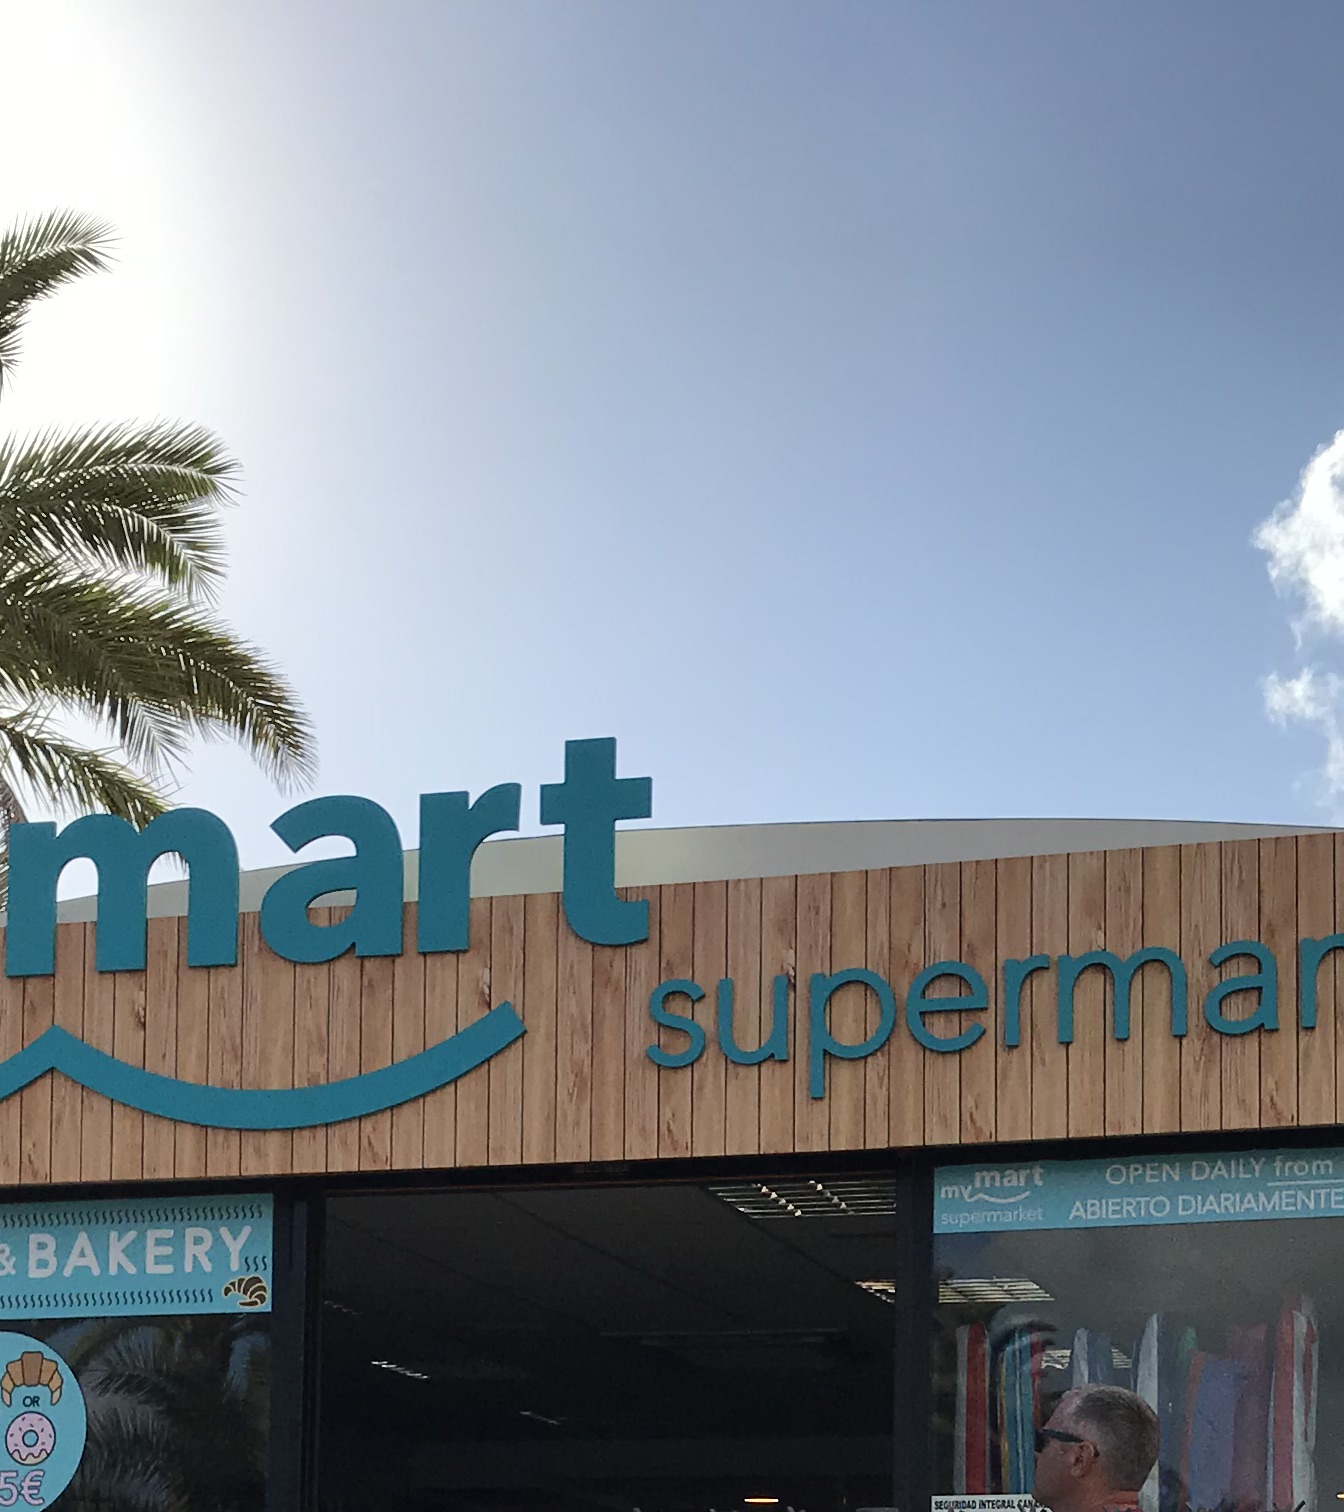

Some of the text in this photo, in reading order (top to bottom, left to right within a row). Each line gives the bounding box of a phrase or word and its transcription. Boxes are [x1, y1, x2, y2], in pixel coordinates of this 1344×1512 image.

[6, 736, 653, 978] mart
[974, 1164, 1045, 1188] mart
[1106, 1162, 1180, 1185] OPEN
[1191, 1157, 1266, 1181] DAILY
[1274, 1154, 1333, 1177] from
[940, 1205, 1045, 1228] supermarket
[1068, 1194, 1170, 1221] ABIERTO
[1178, 1187, 1344, 1216] DIARIAMENTE
[22, 1395, 41, 1408] OR
